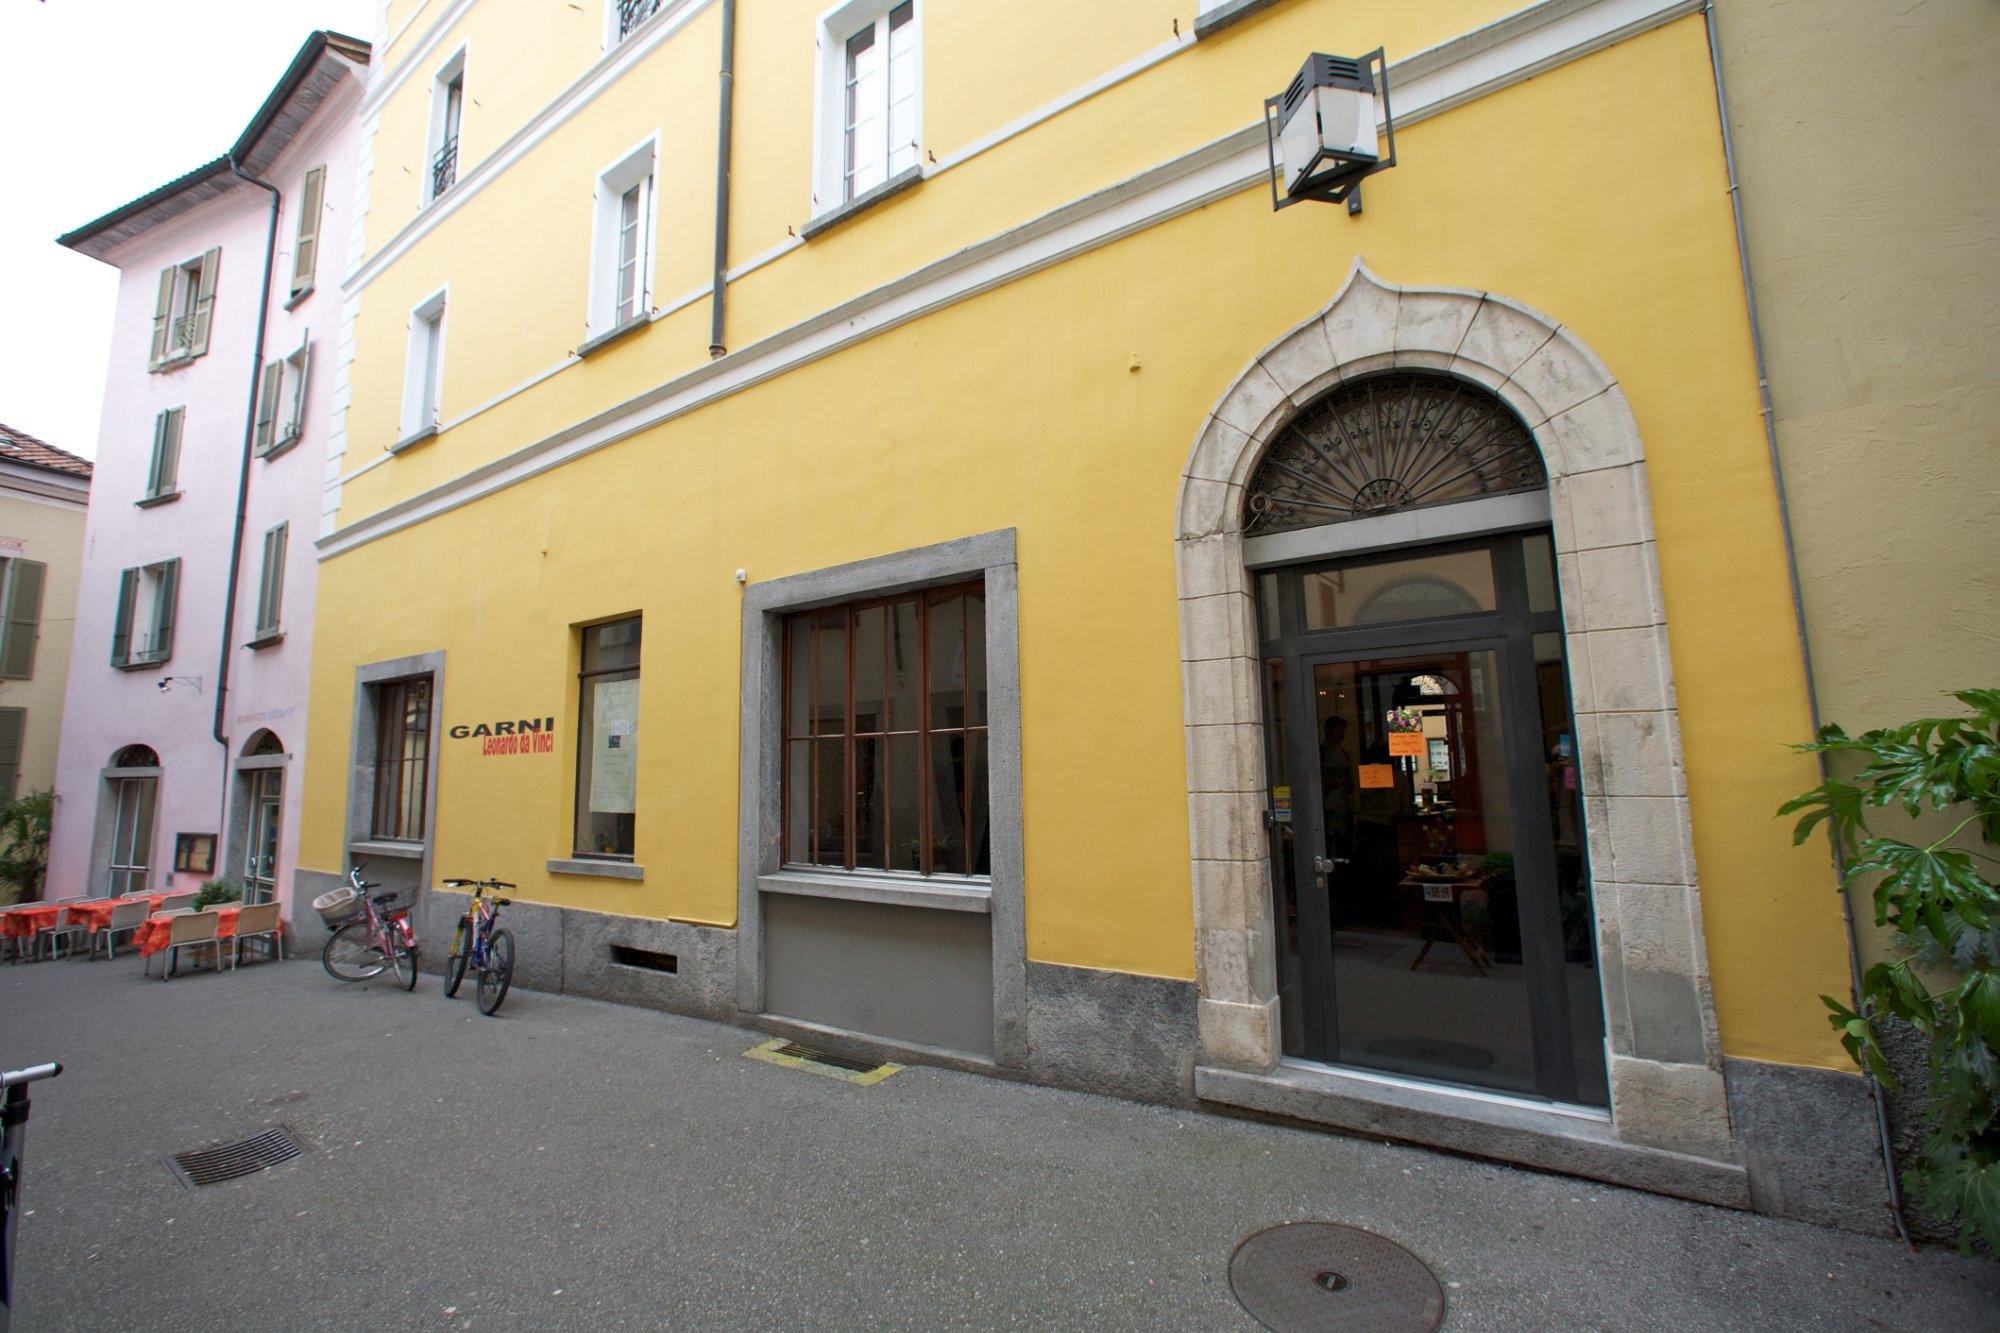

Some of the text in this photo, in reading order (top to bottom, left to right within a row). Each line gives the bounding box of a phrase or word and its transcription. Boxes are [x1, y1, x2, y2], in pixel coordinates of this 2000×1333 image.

[449, 717, 554, 739] GARNI
[483, 731, 554, 756] Leonardo da Vinci
